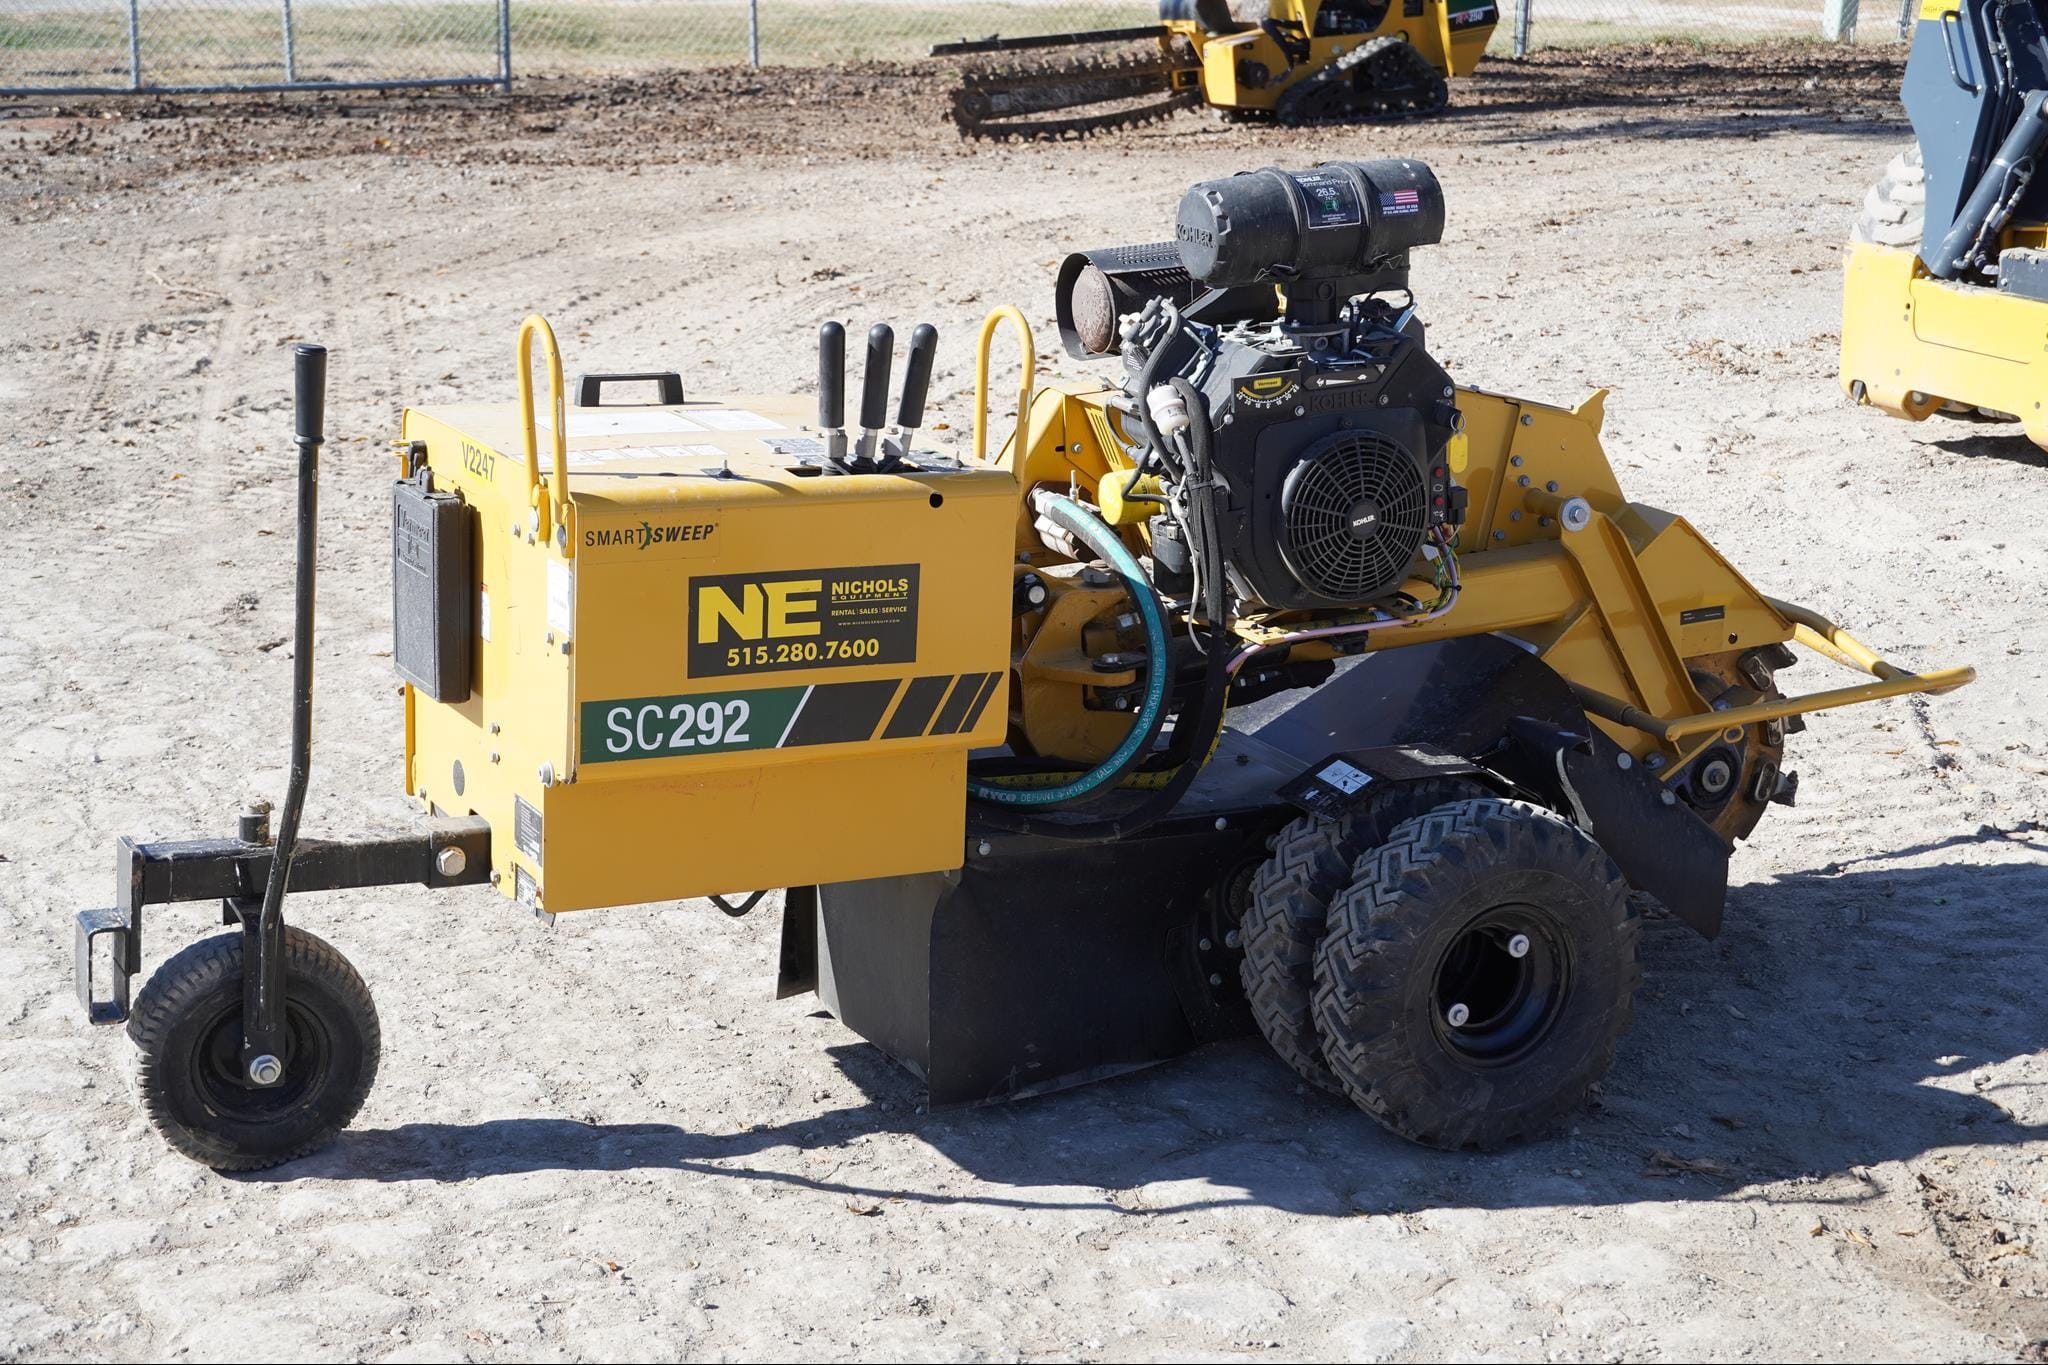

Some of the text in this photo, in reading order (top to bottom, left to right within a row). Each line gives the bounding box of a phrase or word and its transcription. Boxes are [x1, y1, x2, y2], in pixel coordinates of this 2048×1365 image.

[1177, 223, 1215, 249] KOHLER
[462, 441, 495, 482] V2247
[585, 524, 714, 547] SMART SWEEP
[831, 578, 909, 595] NICHOLS
[831, 591, 909, 600] EQUIPMENT
[698, 579, 822, 644] NE
[831, 609, 856, 617] RENTAL
[859, 607, 878, 615] SALES
[727, 638, 880, 667] 515.280.7600
[606, 699, 750, 753] SC292
